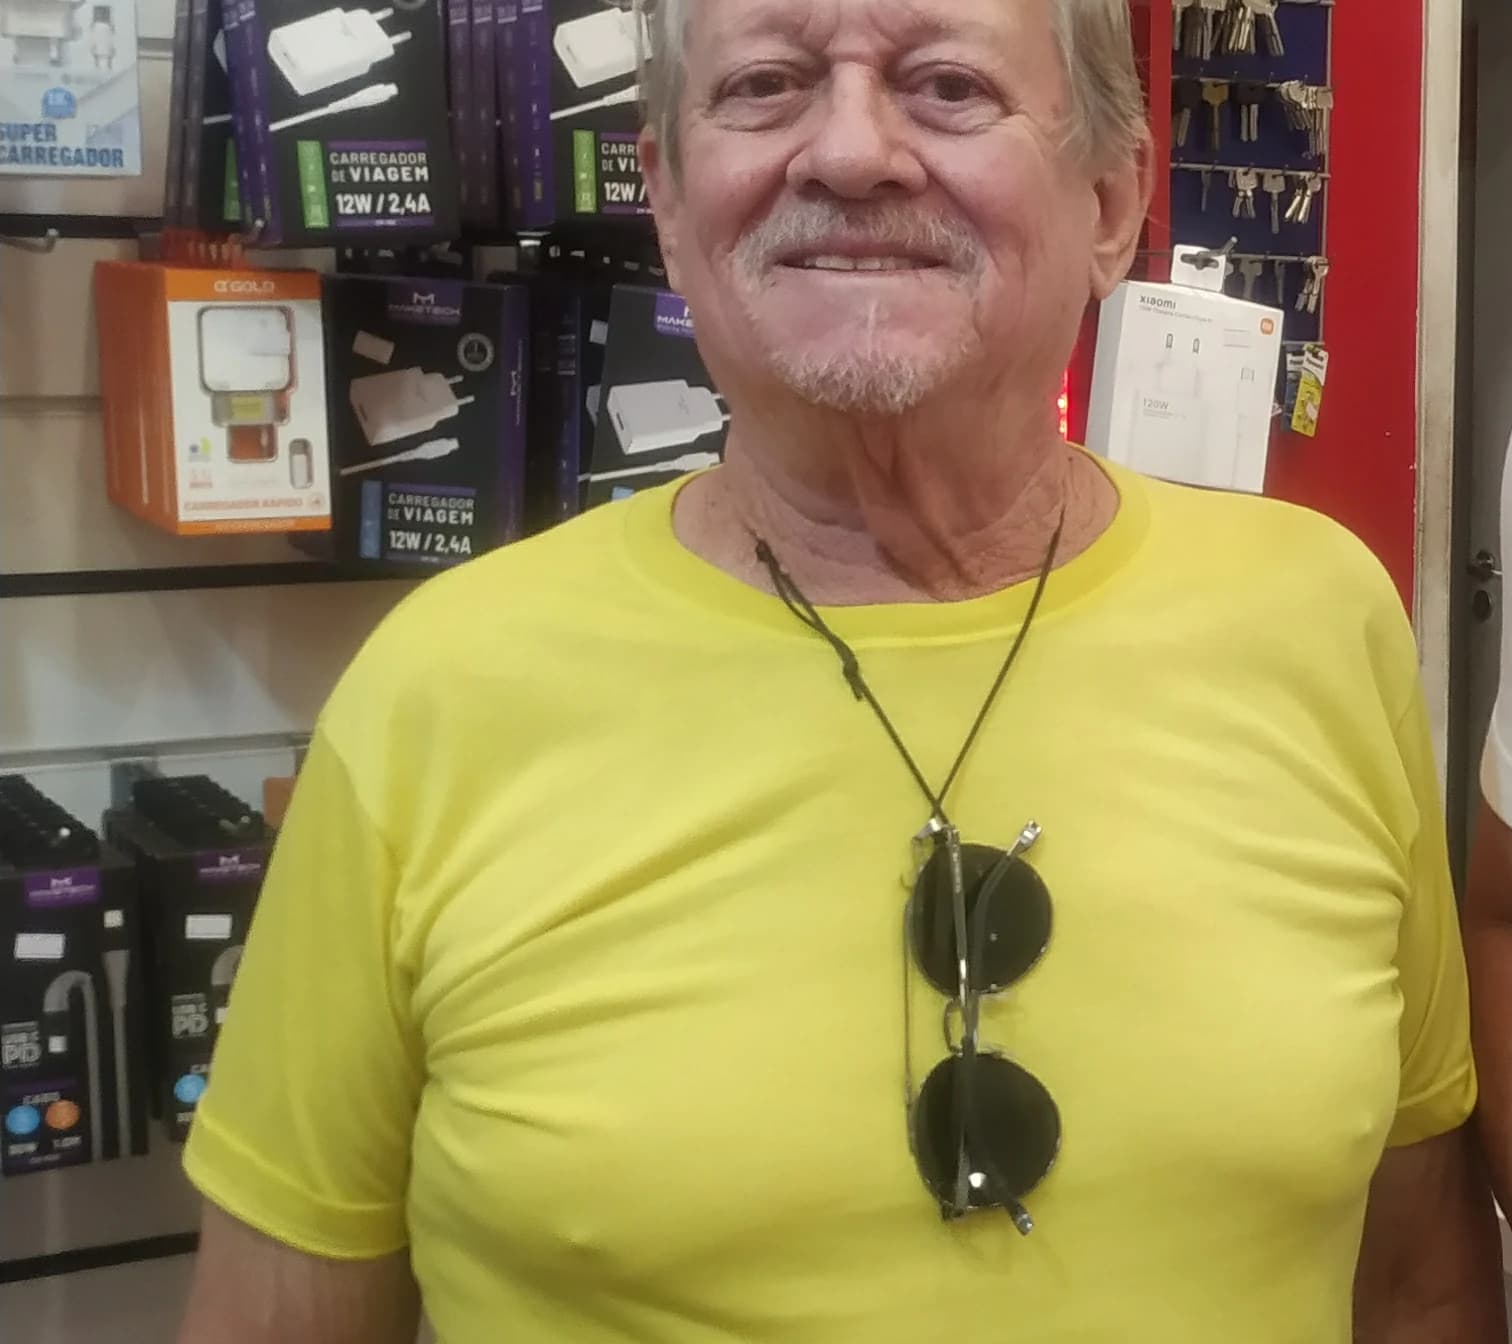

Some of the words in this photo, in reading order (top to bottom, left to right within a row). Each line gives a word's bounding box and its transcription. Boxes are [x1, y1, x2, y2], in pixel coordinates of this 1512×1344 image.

[329, 152, 428, 166] CARREGADOR
[350, 166, 430, 182] VIAGEM
[604, 182, 637, 203] 12W
[336, 192, 373, 215] 12W
[388, 192, 432, 216] 2,4A
[388, 492, 475, 510] CARREGADOR
[403, 506, 474, 525] VIAGEM
[389, 530, 422, 551] 12W
[434, 533, 472, 555] 2,4A
